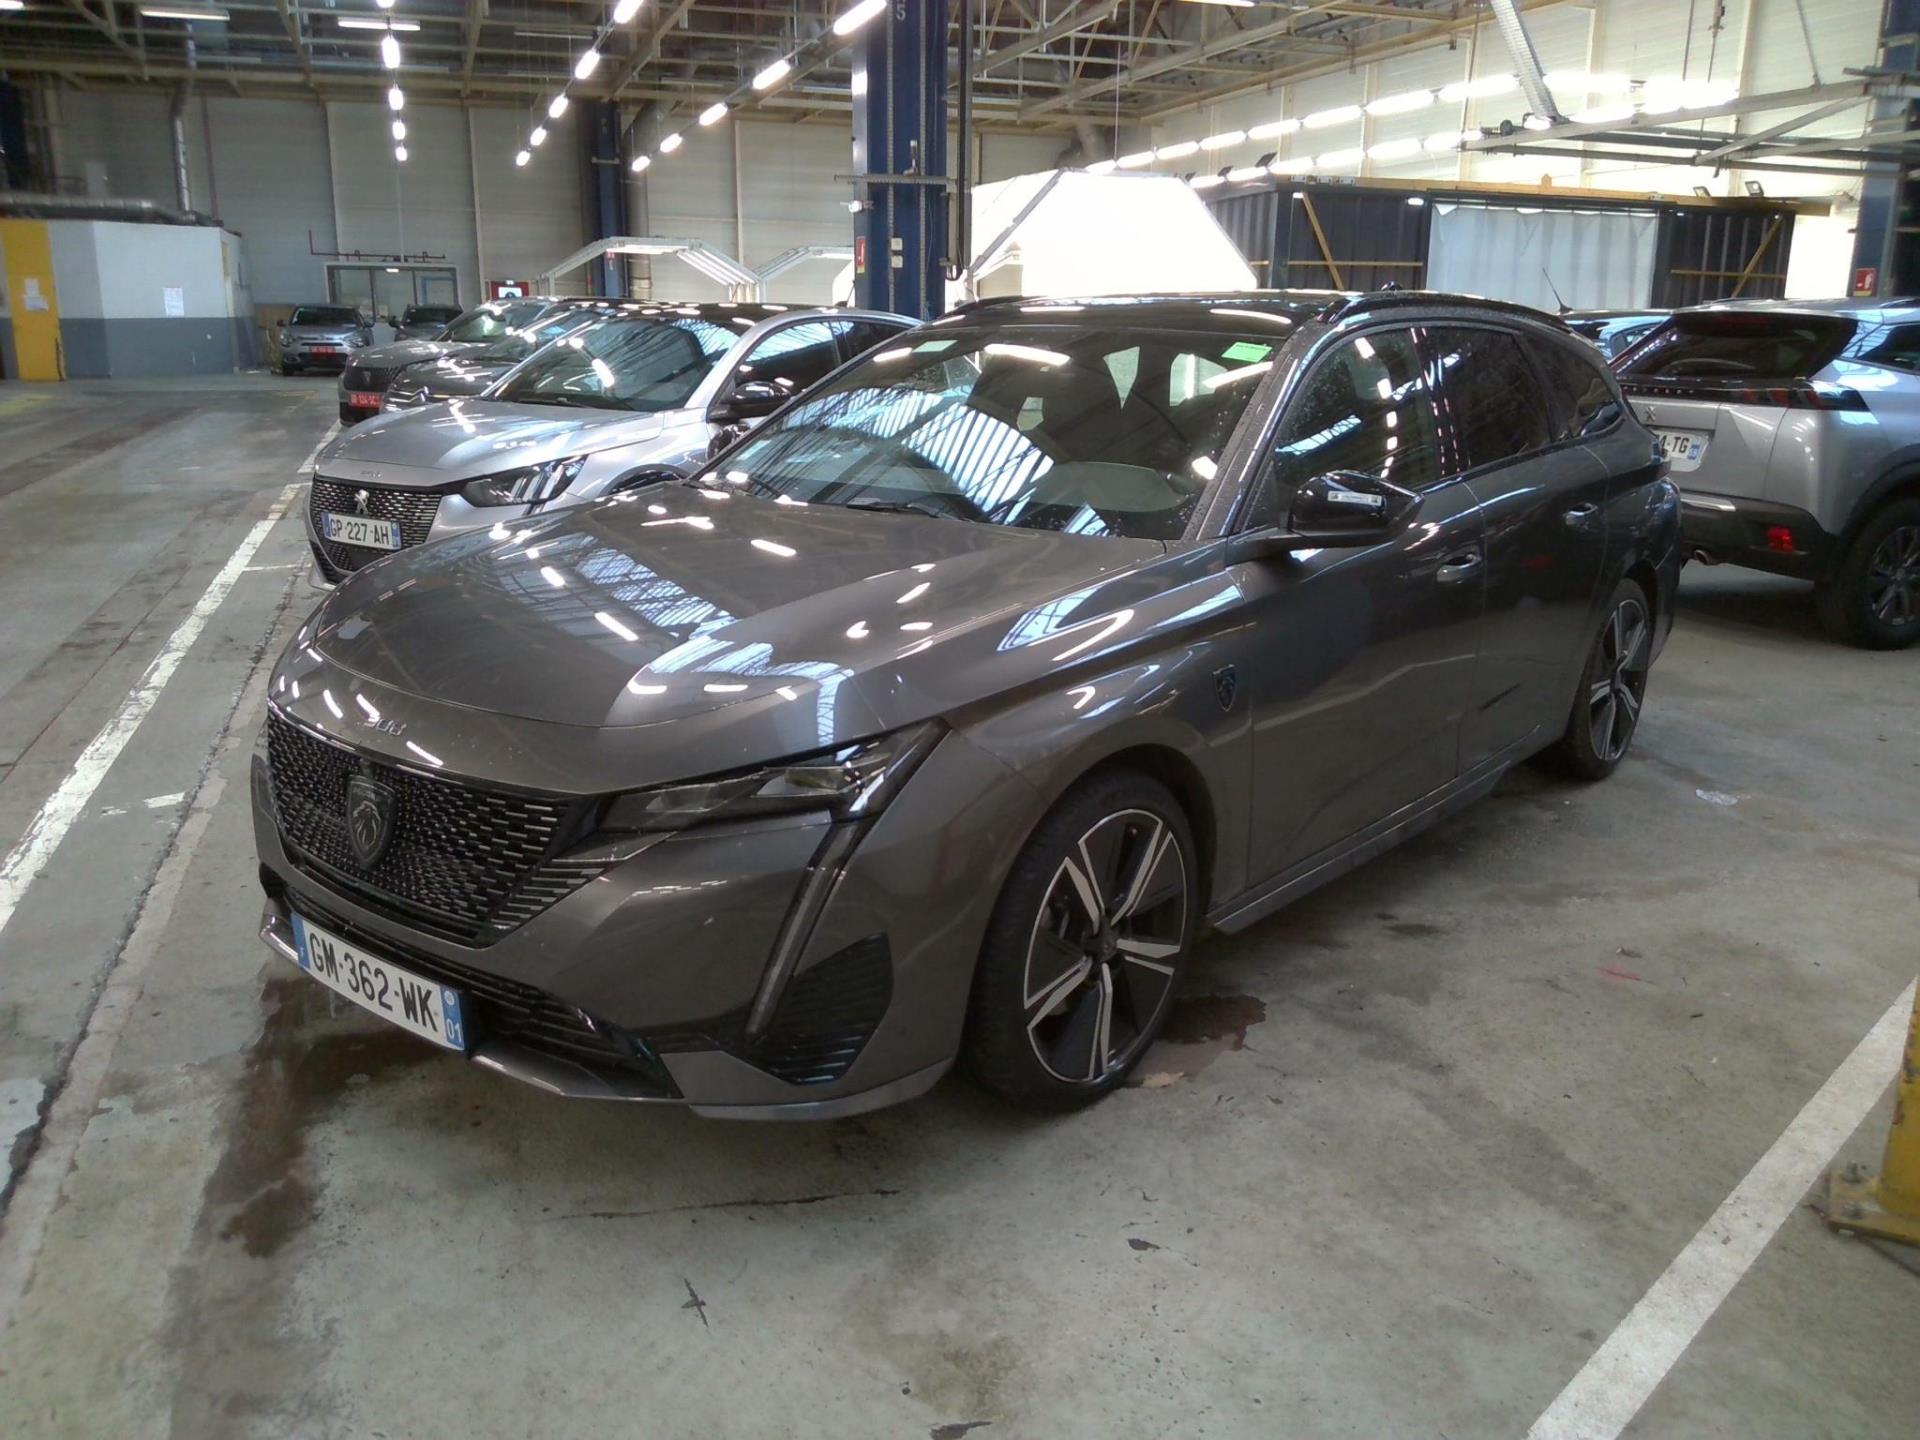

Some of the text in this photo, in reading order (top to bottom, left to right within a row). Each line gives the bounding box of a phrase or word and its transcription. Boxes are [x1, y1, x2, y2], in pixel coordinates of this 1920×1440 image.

[330, 519, 389, 545] GP-227-AH
[309, 933, 438, 1032] GM-362-WK
[446, 1018, 462, 1043] 01
